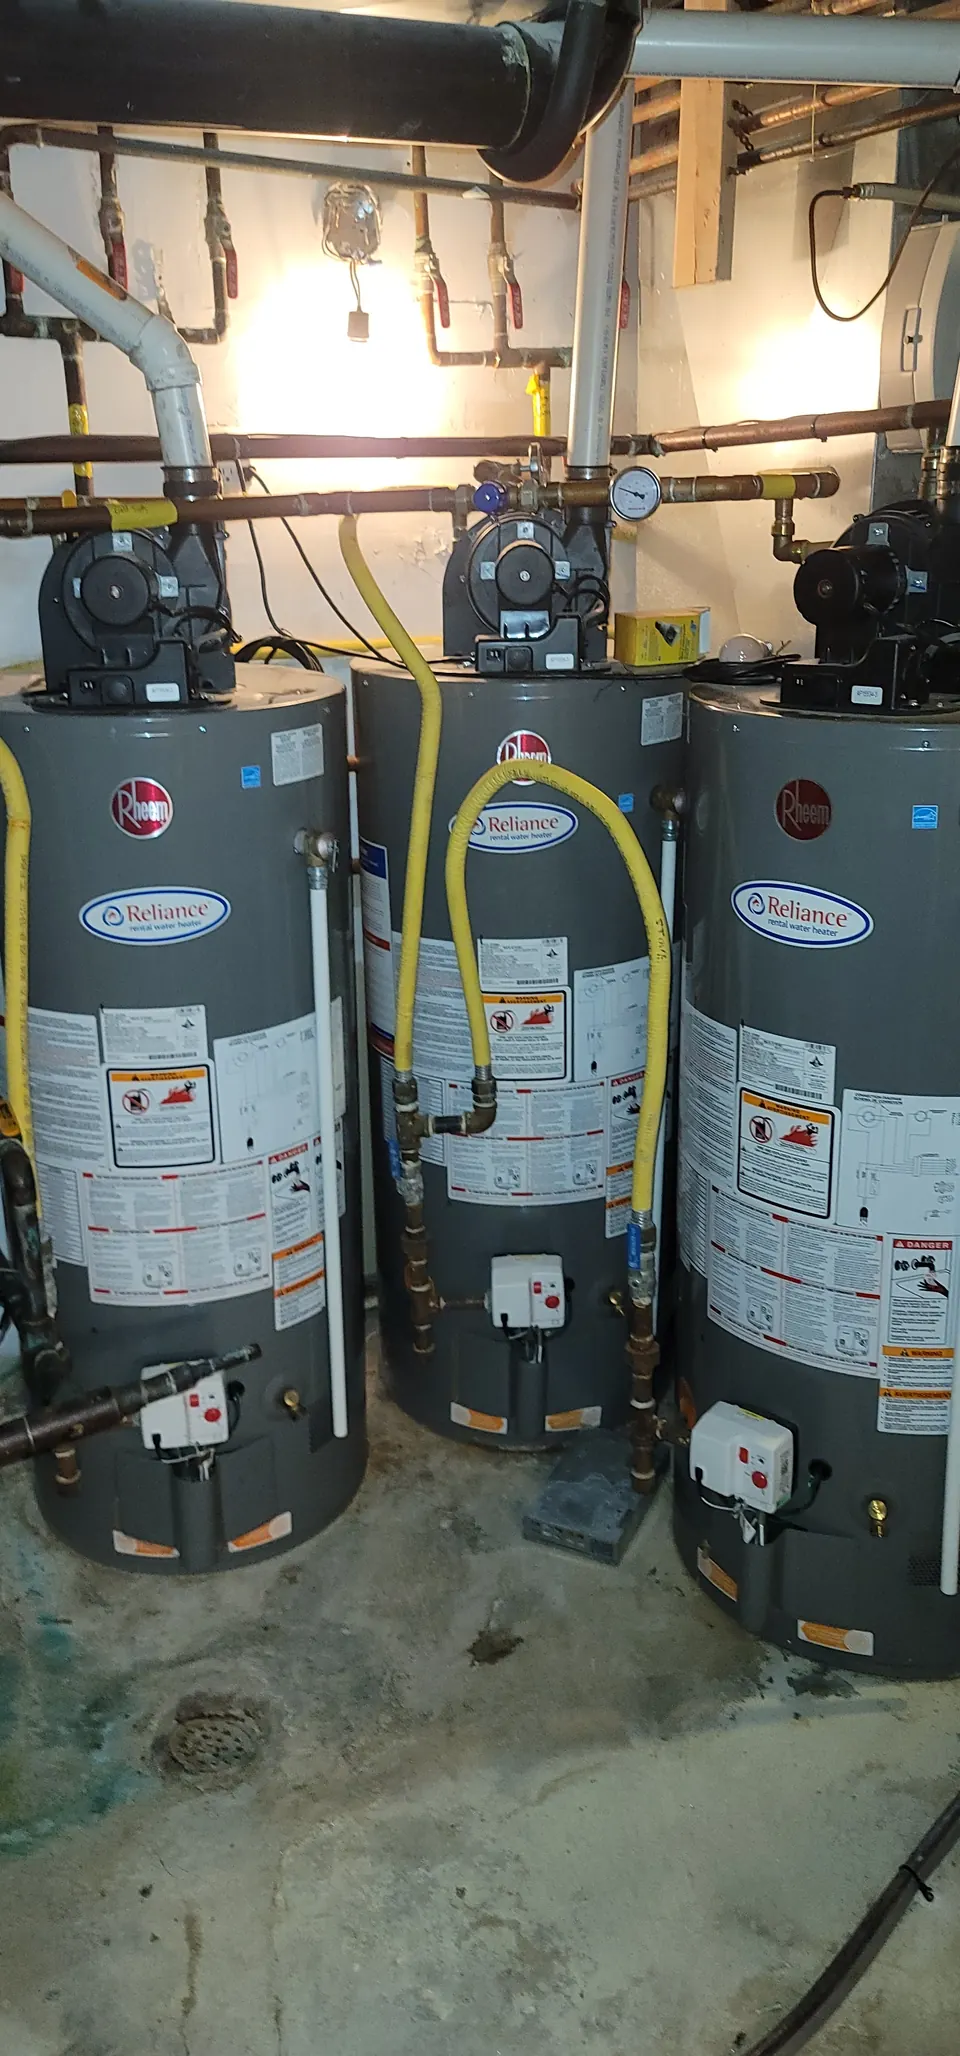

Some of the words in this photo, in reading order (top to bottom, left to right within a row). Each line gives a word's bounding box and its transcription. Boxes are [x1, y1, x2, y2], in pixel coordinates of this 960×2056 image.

[117, 780, 170, 829] Rheem
[782, 780, 830, 831] Rheem
[488, 816, 559, 833] Reliance
[489, 833, 510, 842] rental
[510, 833, 530, 841] water
[531, 832, 553, 840] heater
[126, 903, 209, 923] Reliance
[767, 895, 848, 928] Reliance
[129, 923, 153, 933] rental
[154, 921, 176, 931] water
[177, 919, 202, 929] heater
[767, 918, 789, 929] rental
[789, 922, 812, 933] water
[812, 926, 839, 937] heater
[906, 1241, 949, 1249] DANGER
